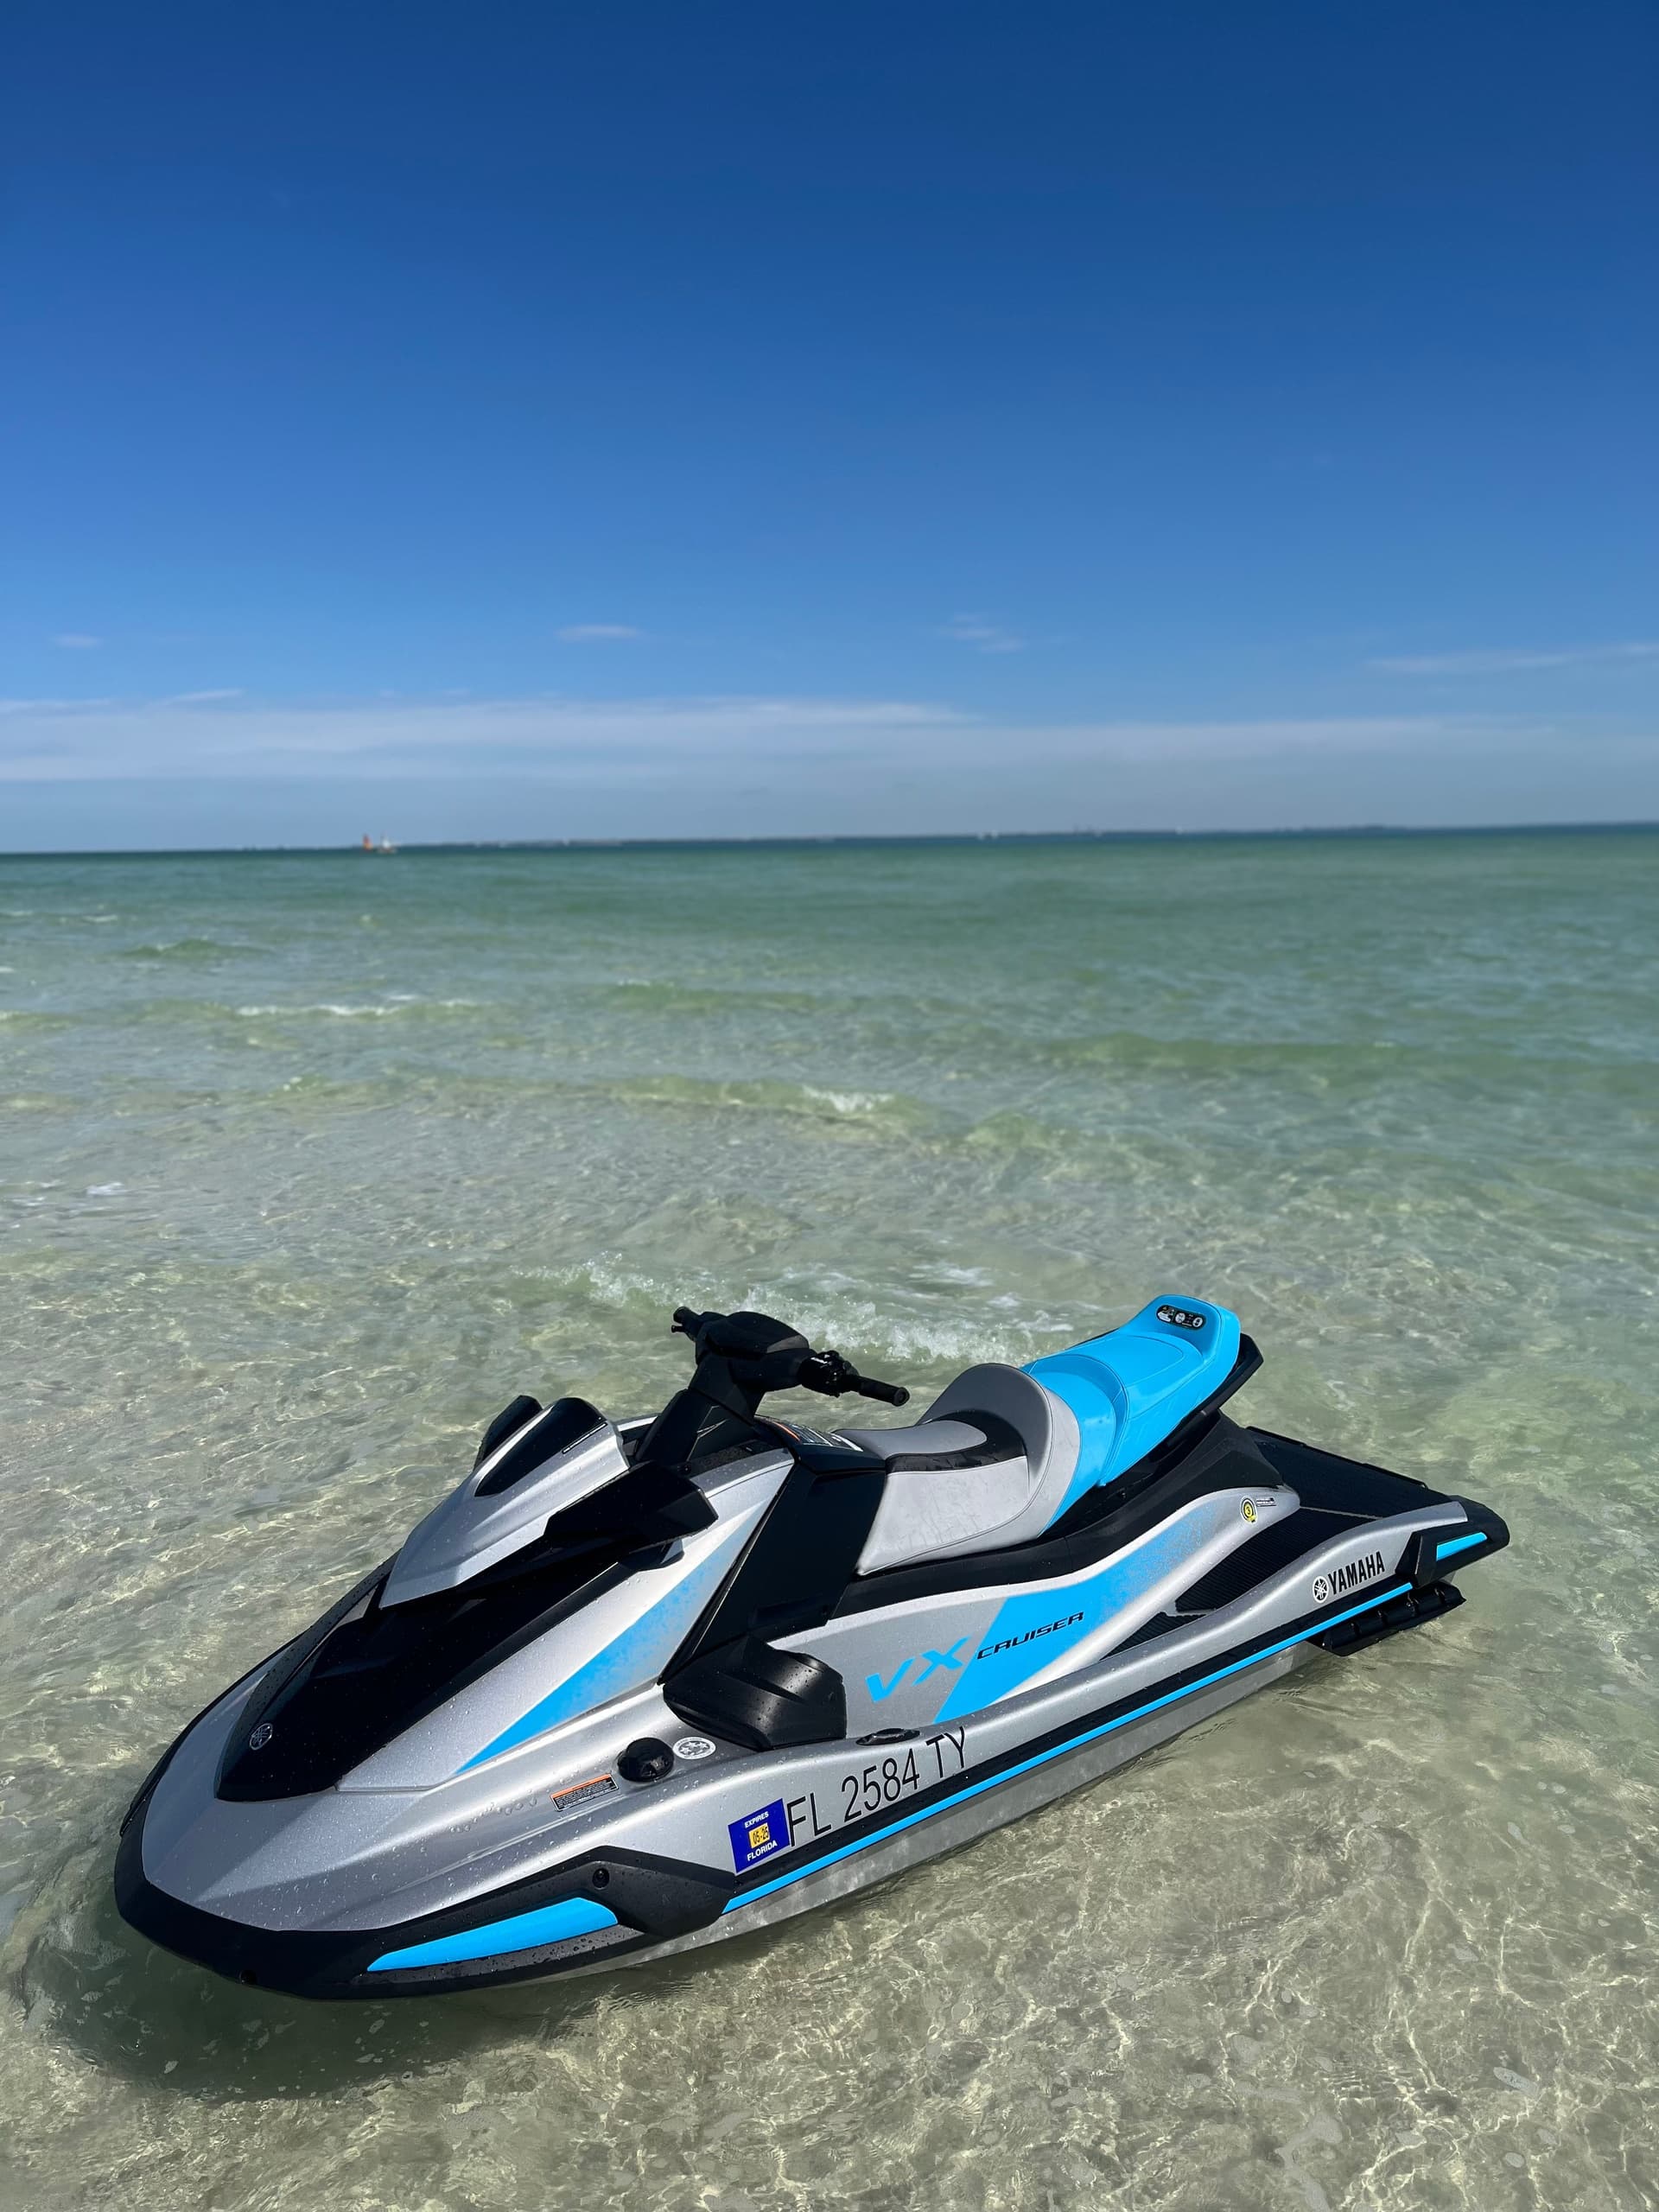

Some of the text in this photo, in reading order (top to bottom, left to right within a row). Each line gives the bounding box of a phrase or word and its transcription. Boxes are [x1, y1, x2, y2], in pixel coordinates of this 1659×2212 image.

[1328, 1551, 1384, 1595] YAMAHA
[866, 1611, 1084, 1703] VX CRUISER
[787, 1726, 965, 1847] FL 2584 TY
[744, 1811, 769, 1828] EXPIRES
[747, 1840, 778, 1862] FLORIDA
